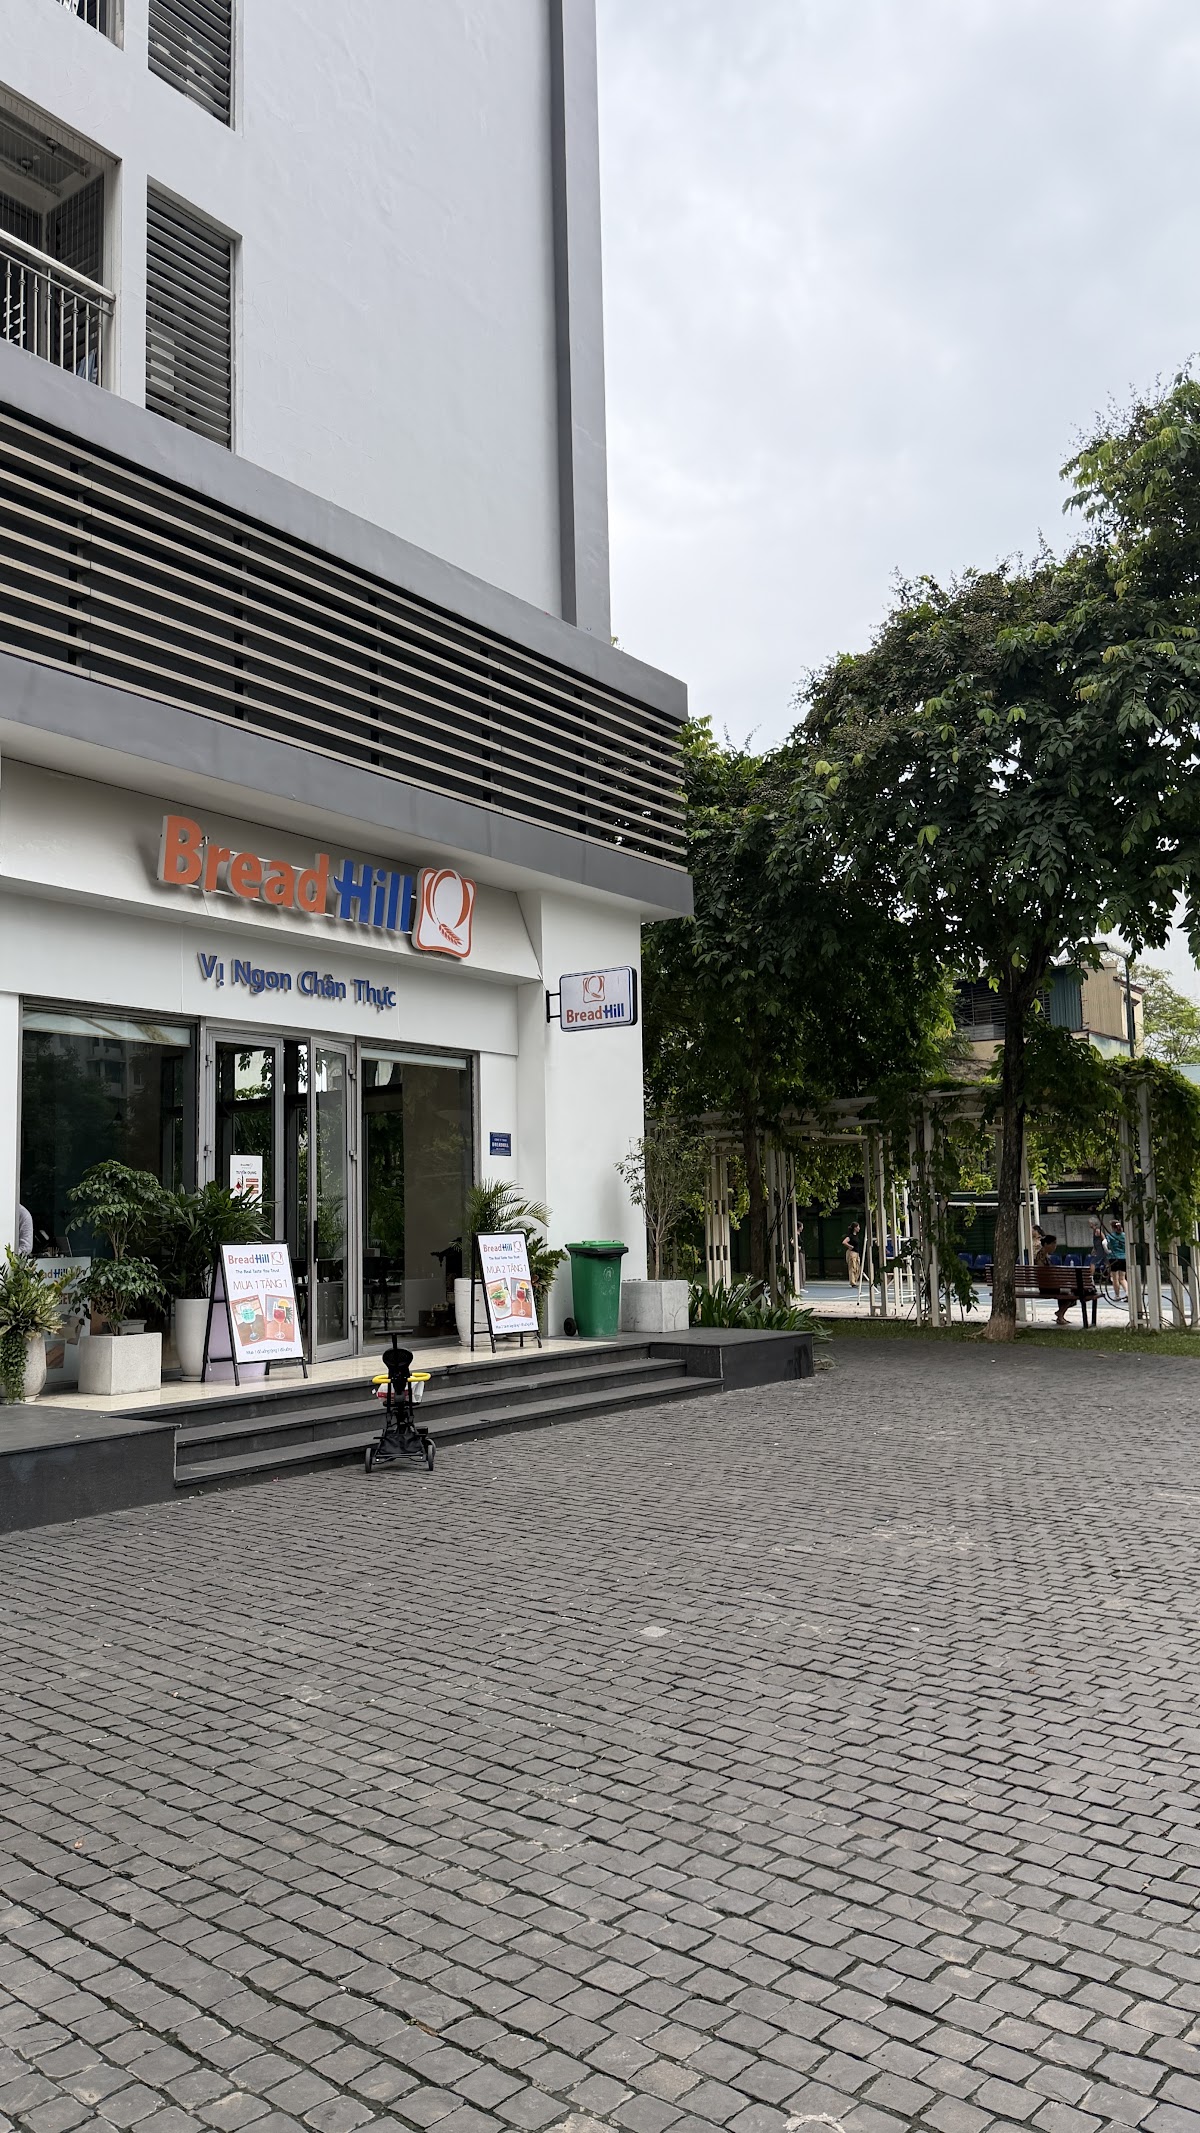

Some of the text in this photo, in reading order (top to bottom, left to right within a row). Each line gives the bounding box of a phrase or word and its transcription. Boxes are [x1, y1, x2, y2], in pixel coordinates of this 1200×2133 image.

[198, 953, 397, 1012] Vị Ngon Chân Thực
[486, 1265, 501, 1274] MUA
[233, 1280, 254, 1290] MUA
